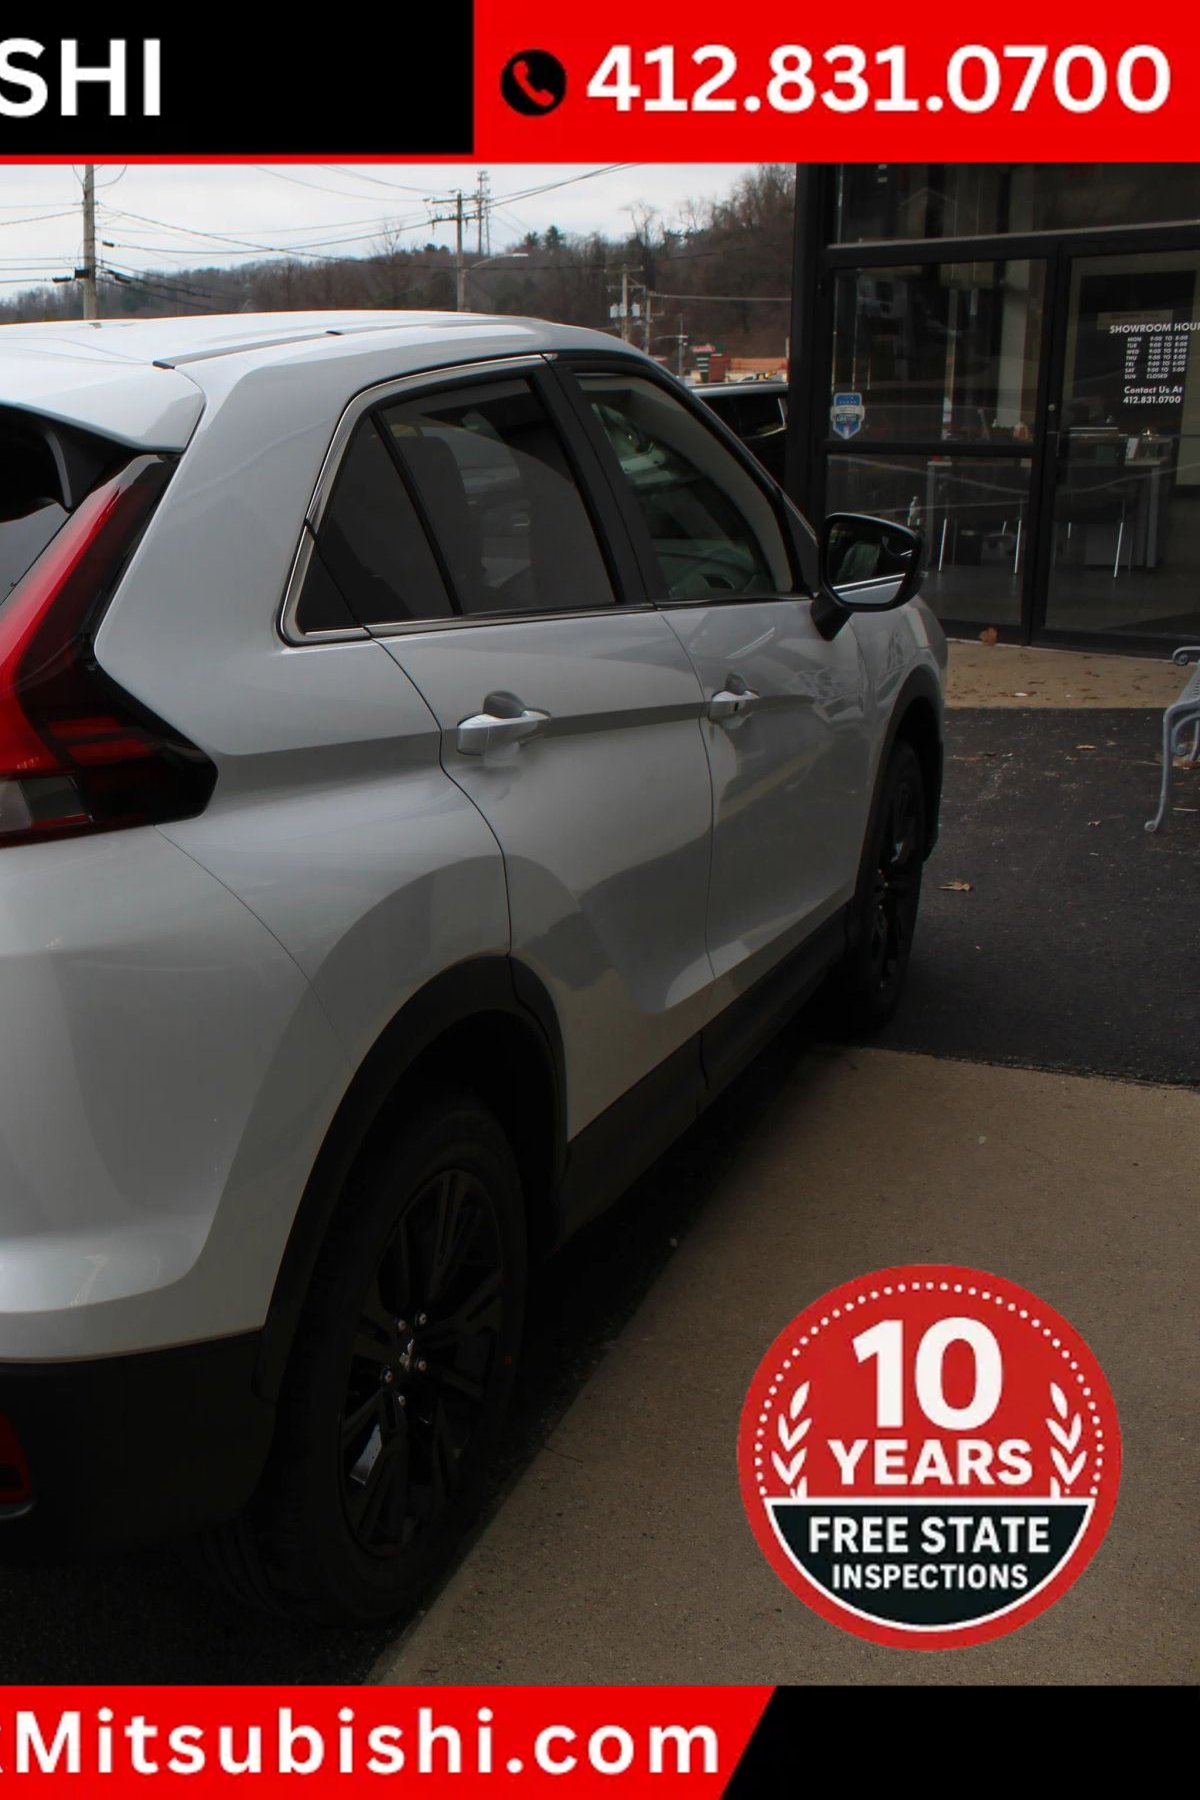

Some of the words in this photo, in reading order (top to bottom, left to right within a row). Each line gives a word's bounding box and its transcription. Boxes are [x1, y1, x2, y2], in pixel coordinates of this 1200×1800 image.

[1109, 323, 1172, 334] SHOWROOM
[1124, 385, 1157, 394] Contact
[1158, 385, 1170, 394] Us
[1171, 385, 1183, 394] At
[1123, 395, 1182, 404] 412.831.0700
